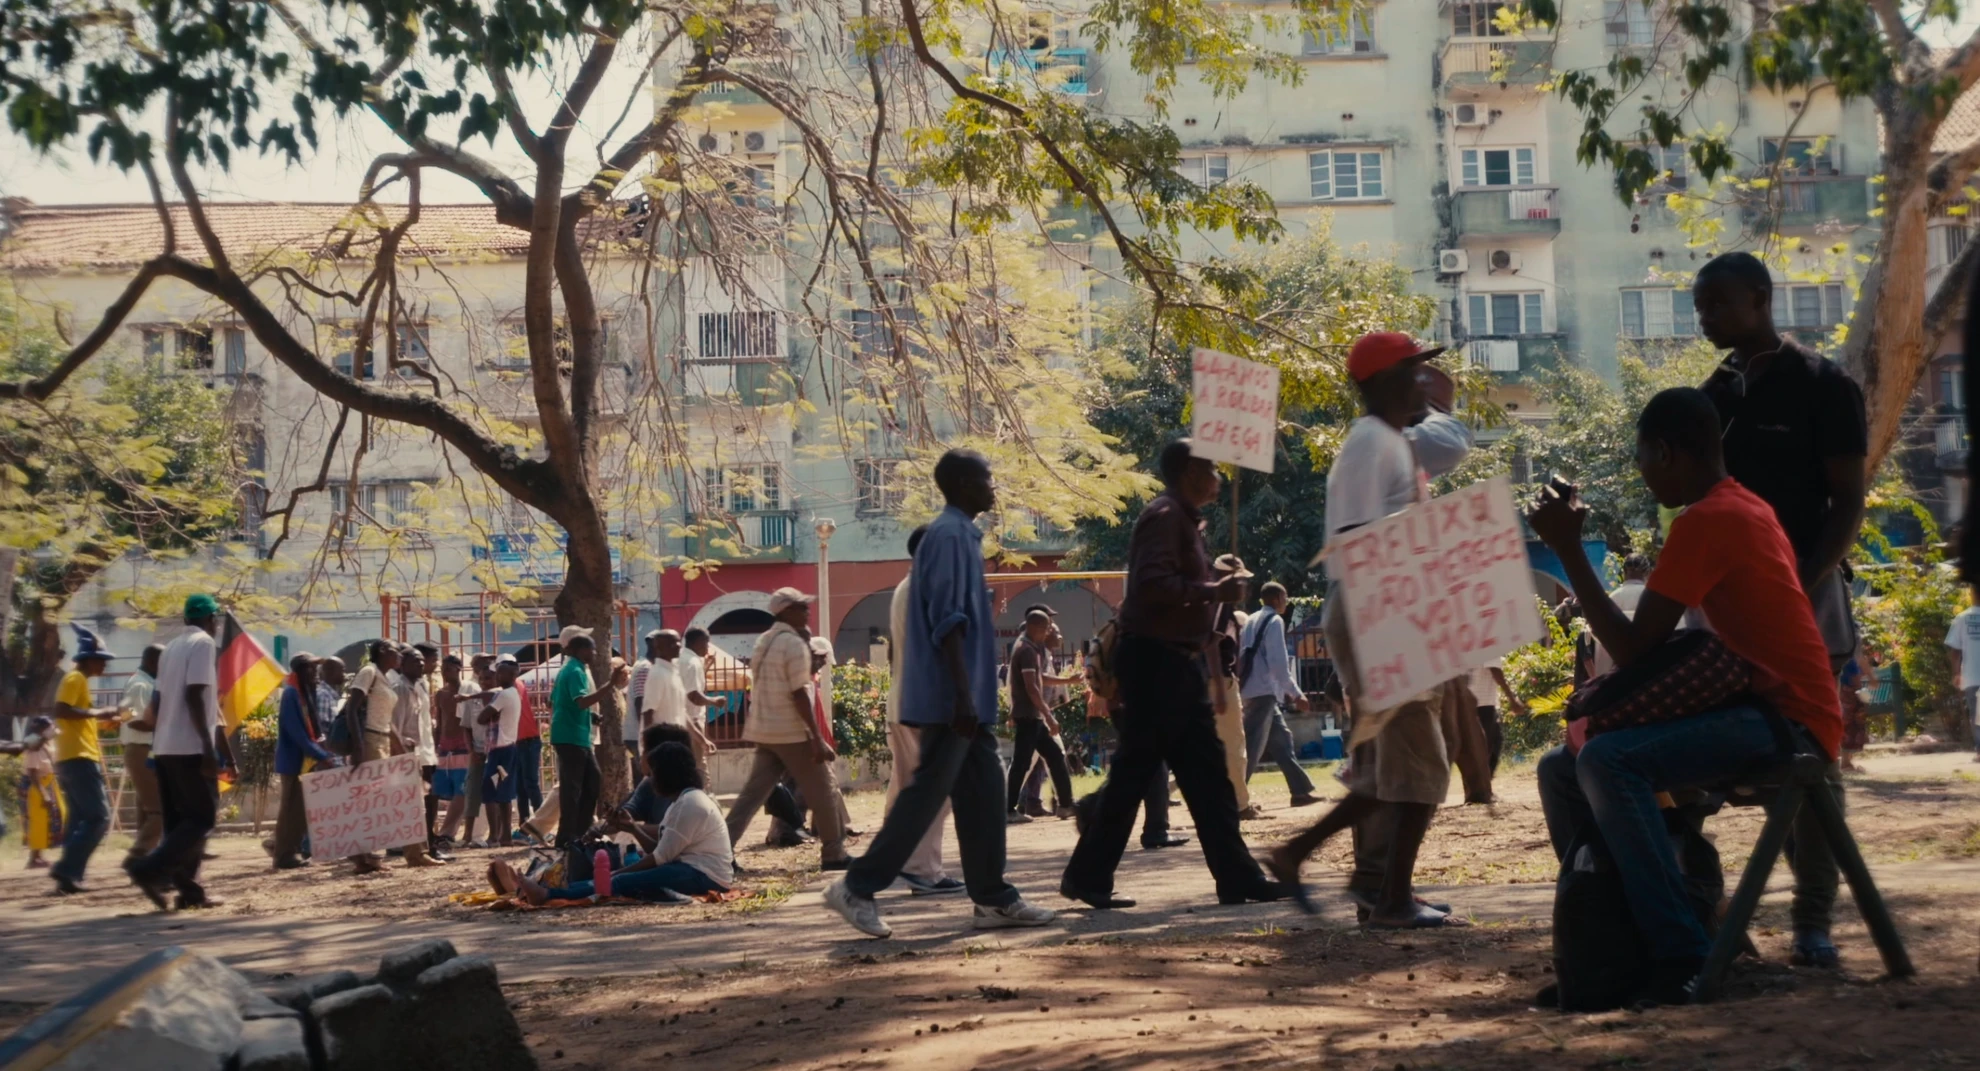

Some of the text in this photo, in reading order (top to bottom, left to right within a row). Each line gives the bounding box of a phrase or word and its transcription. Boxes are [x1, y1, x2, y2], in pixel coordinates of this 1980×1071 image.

[1197, 386, 1209, 402] A
[1422, 527, 1522, 596] MERECE
[1407, 581, 1494, 633] VOTO
[1367, 653, 1410, 700] EM
[307, 785, 417, 824] ROUBARAM
